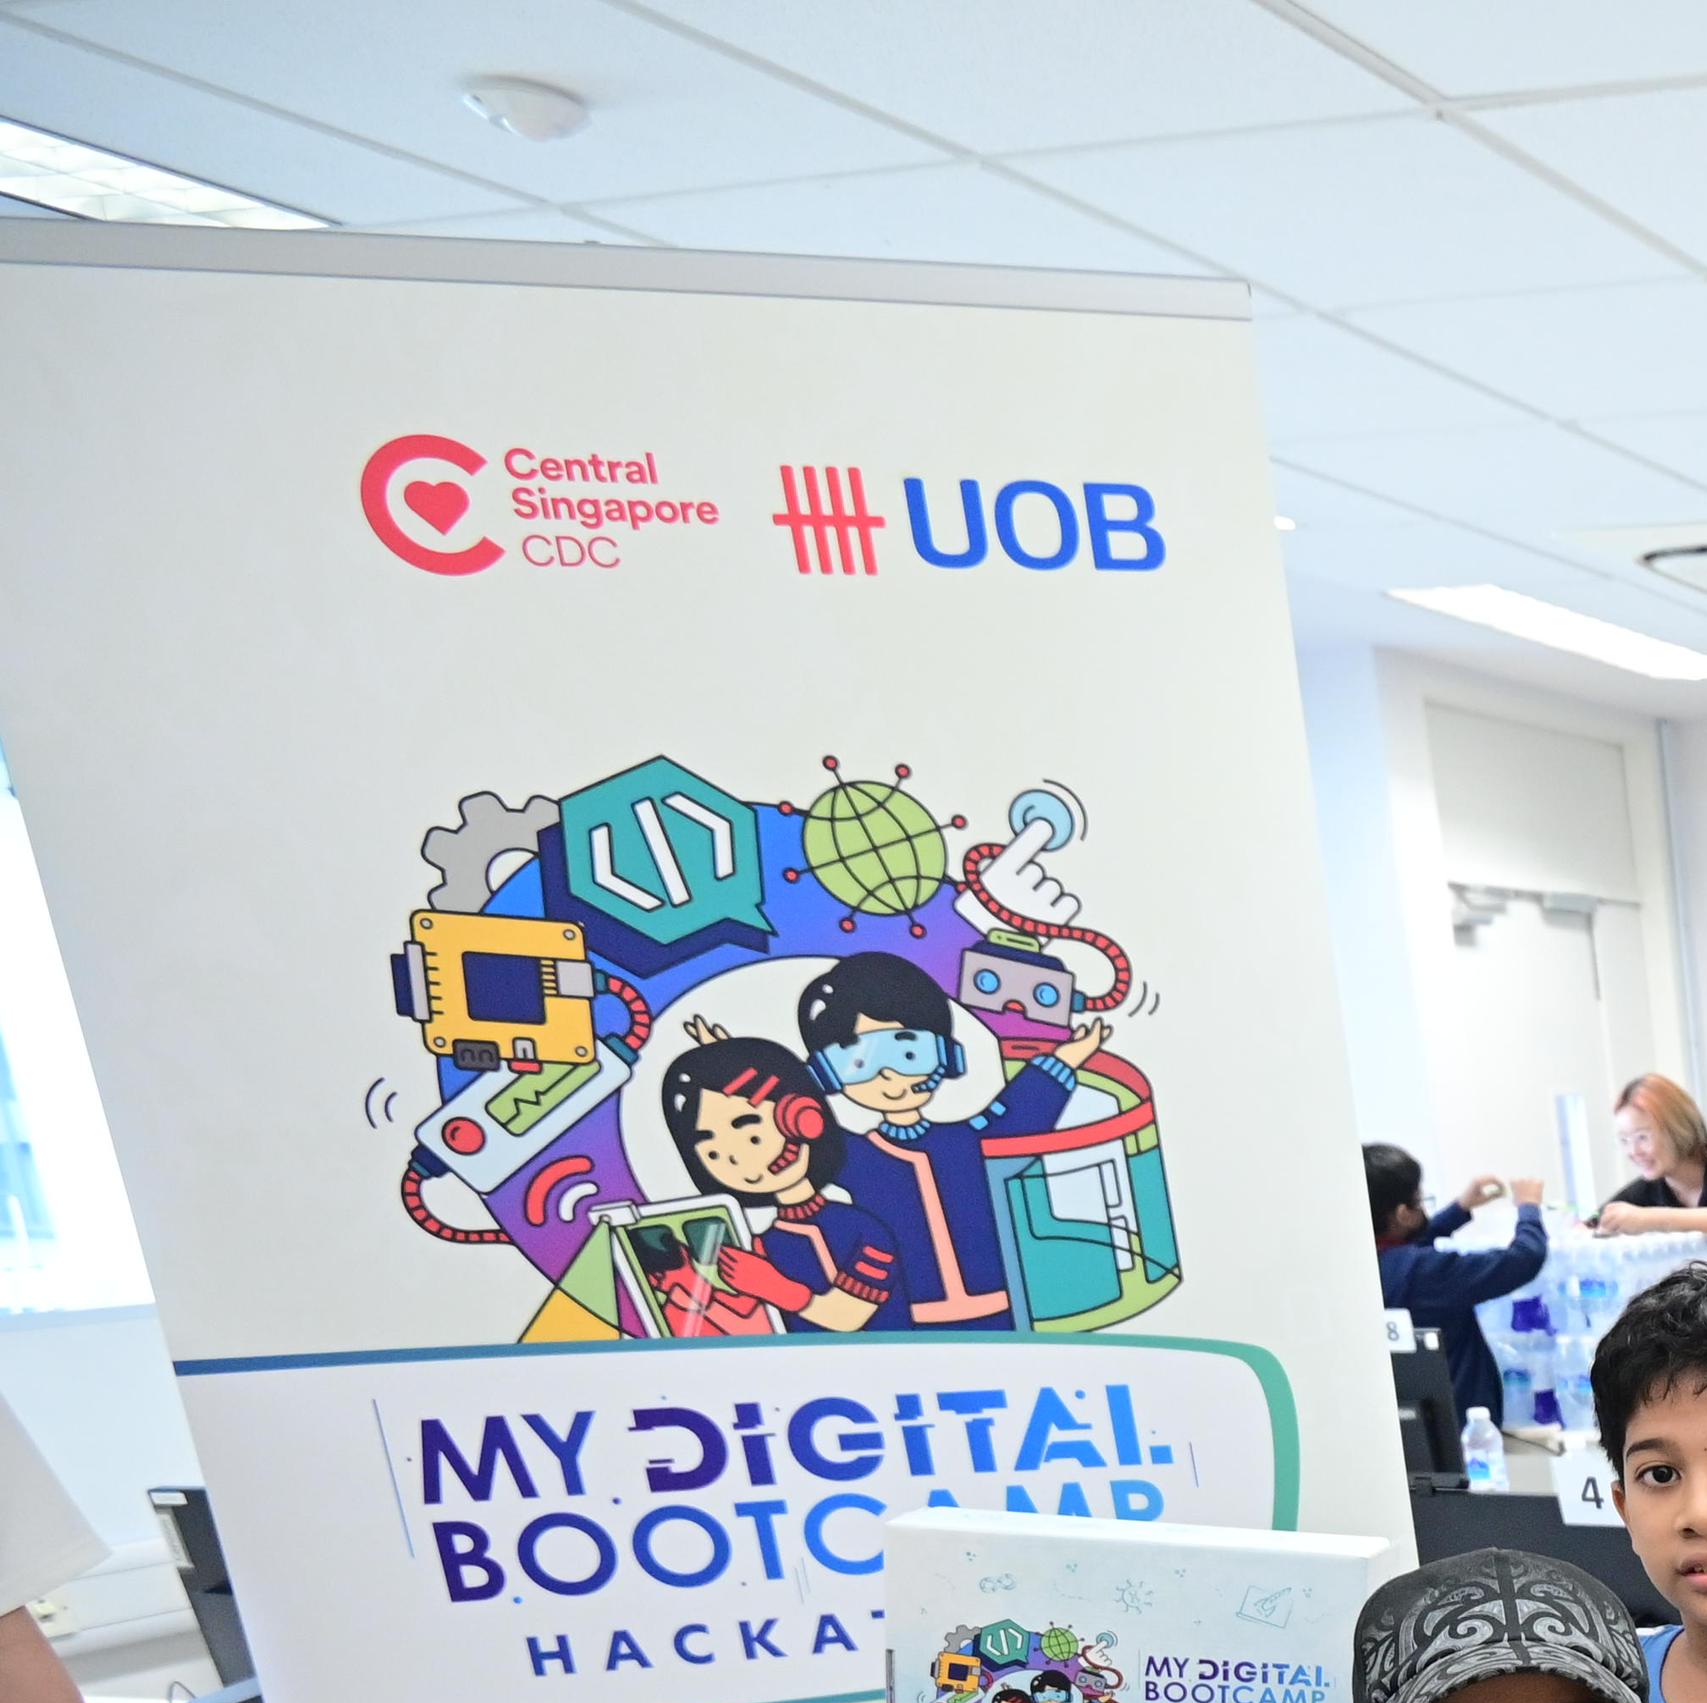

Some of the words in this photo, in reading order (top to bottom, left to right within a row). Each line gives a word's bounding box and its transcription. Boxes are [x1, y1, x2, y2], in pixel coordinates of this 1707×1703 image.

[505, 447, 657, 485] Central
[511, 488, 720, 529] Singapore
[903, 478, 1166, 571] UOB
[522, 534, 620, 568] CDC
[1386, 1321, 1400, 1341] 8
[422, 1410, 595, 1504] MY
[1581, 1477, 1604, 1509] 4
[1145, 1656, 1190, 1678] MY
